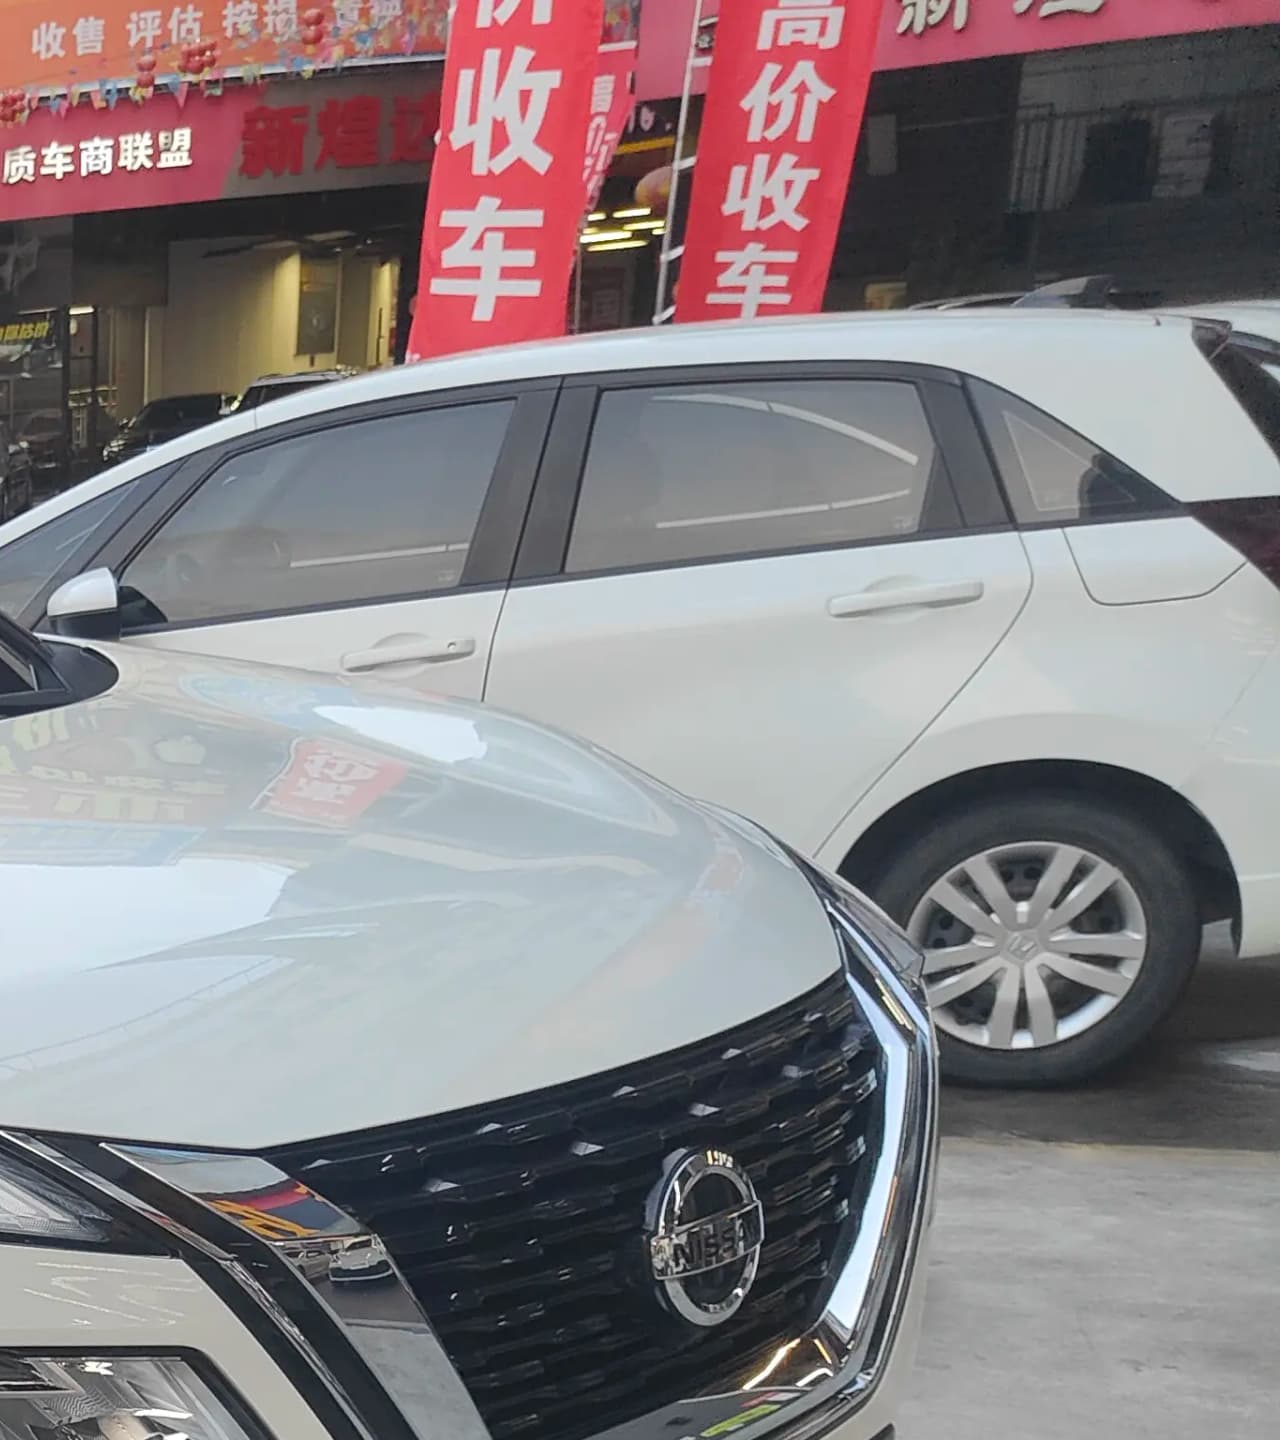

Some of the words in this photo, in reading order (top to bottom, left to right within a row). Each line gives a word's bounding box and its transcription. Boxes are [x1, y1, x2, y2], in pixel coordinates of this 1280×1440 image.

[31, 17, 106, 61] 收售
[127, 4, 204, 49] 评估
[430, 0, 562, 322] 收车
[705, 0, 846, 319] 高价收车
